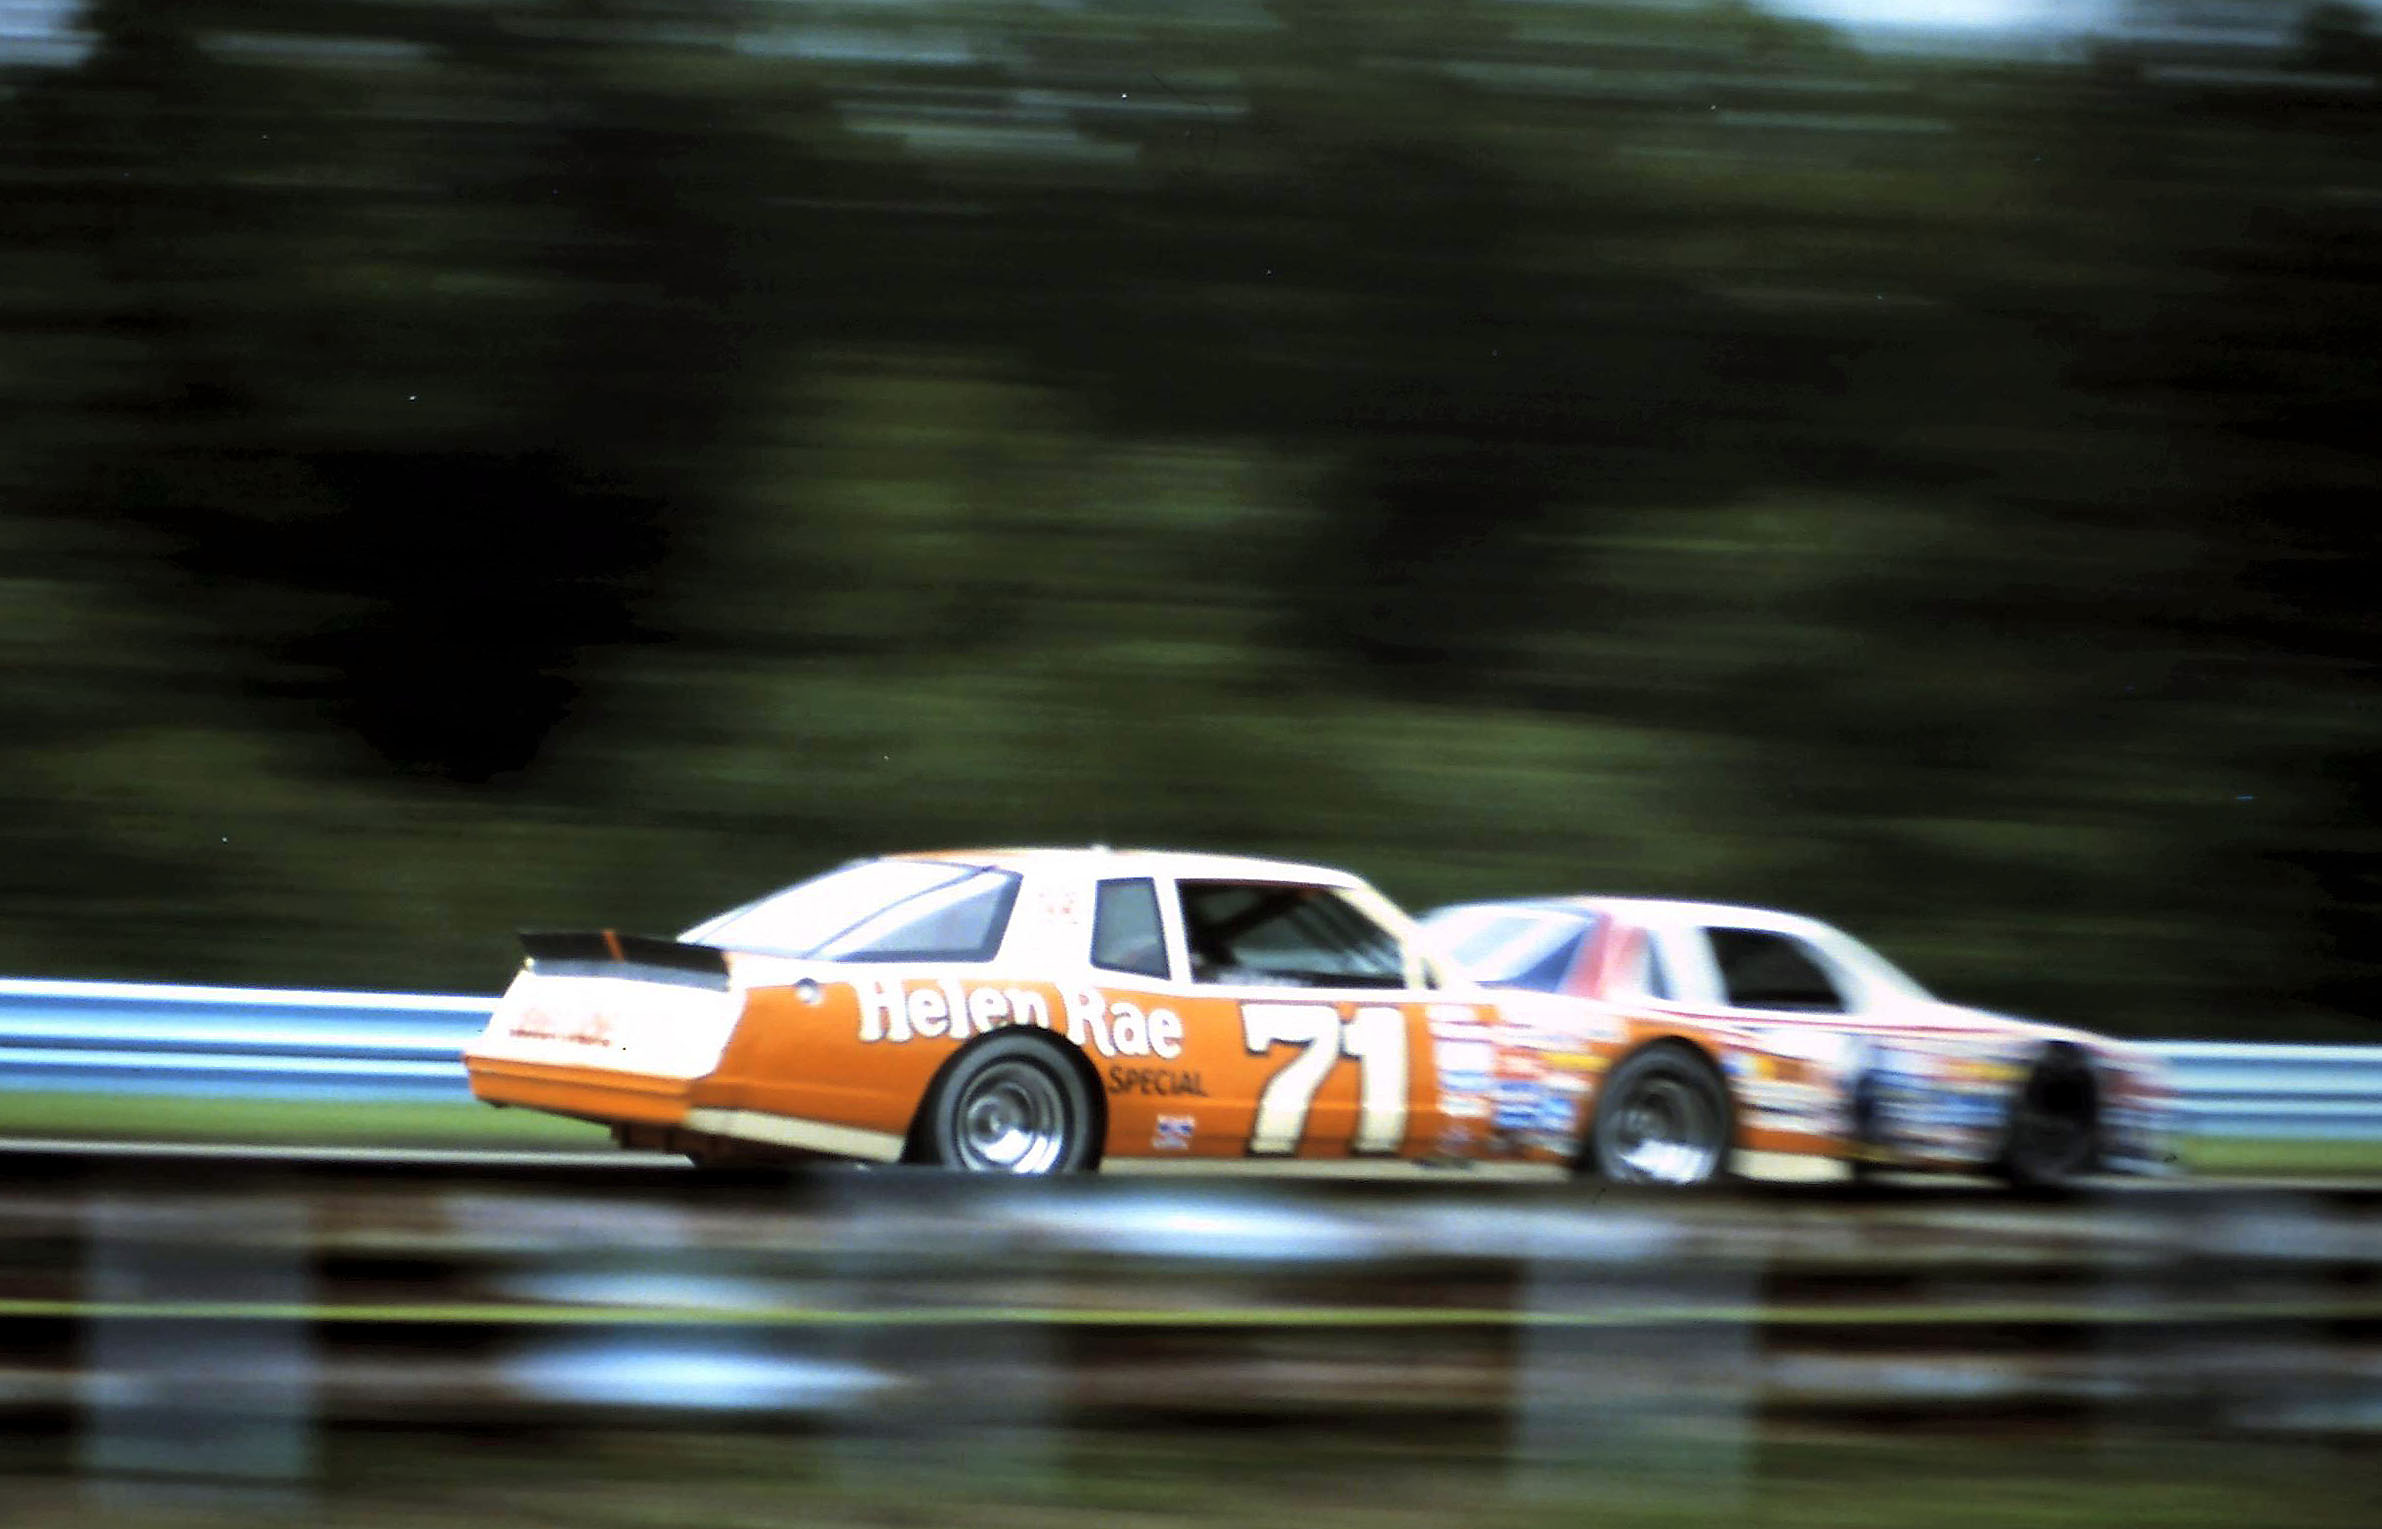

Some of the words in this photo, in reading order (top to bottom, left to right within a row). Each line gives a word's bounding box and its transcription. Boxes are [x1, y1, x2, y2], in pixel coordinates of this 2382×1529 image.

[856, 977, 1052, 1043] Helen
[1056, 982, 1184, 1059] Rae
[1108, 1065, 1208, 1098] SPECIAL
[1239, 1001, 1407, 1157] 71
